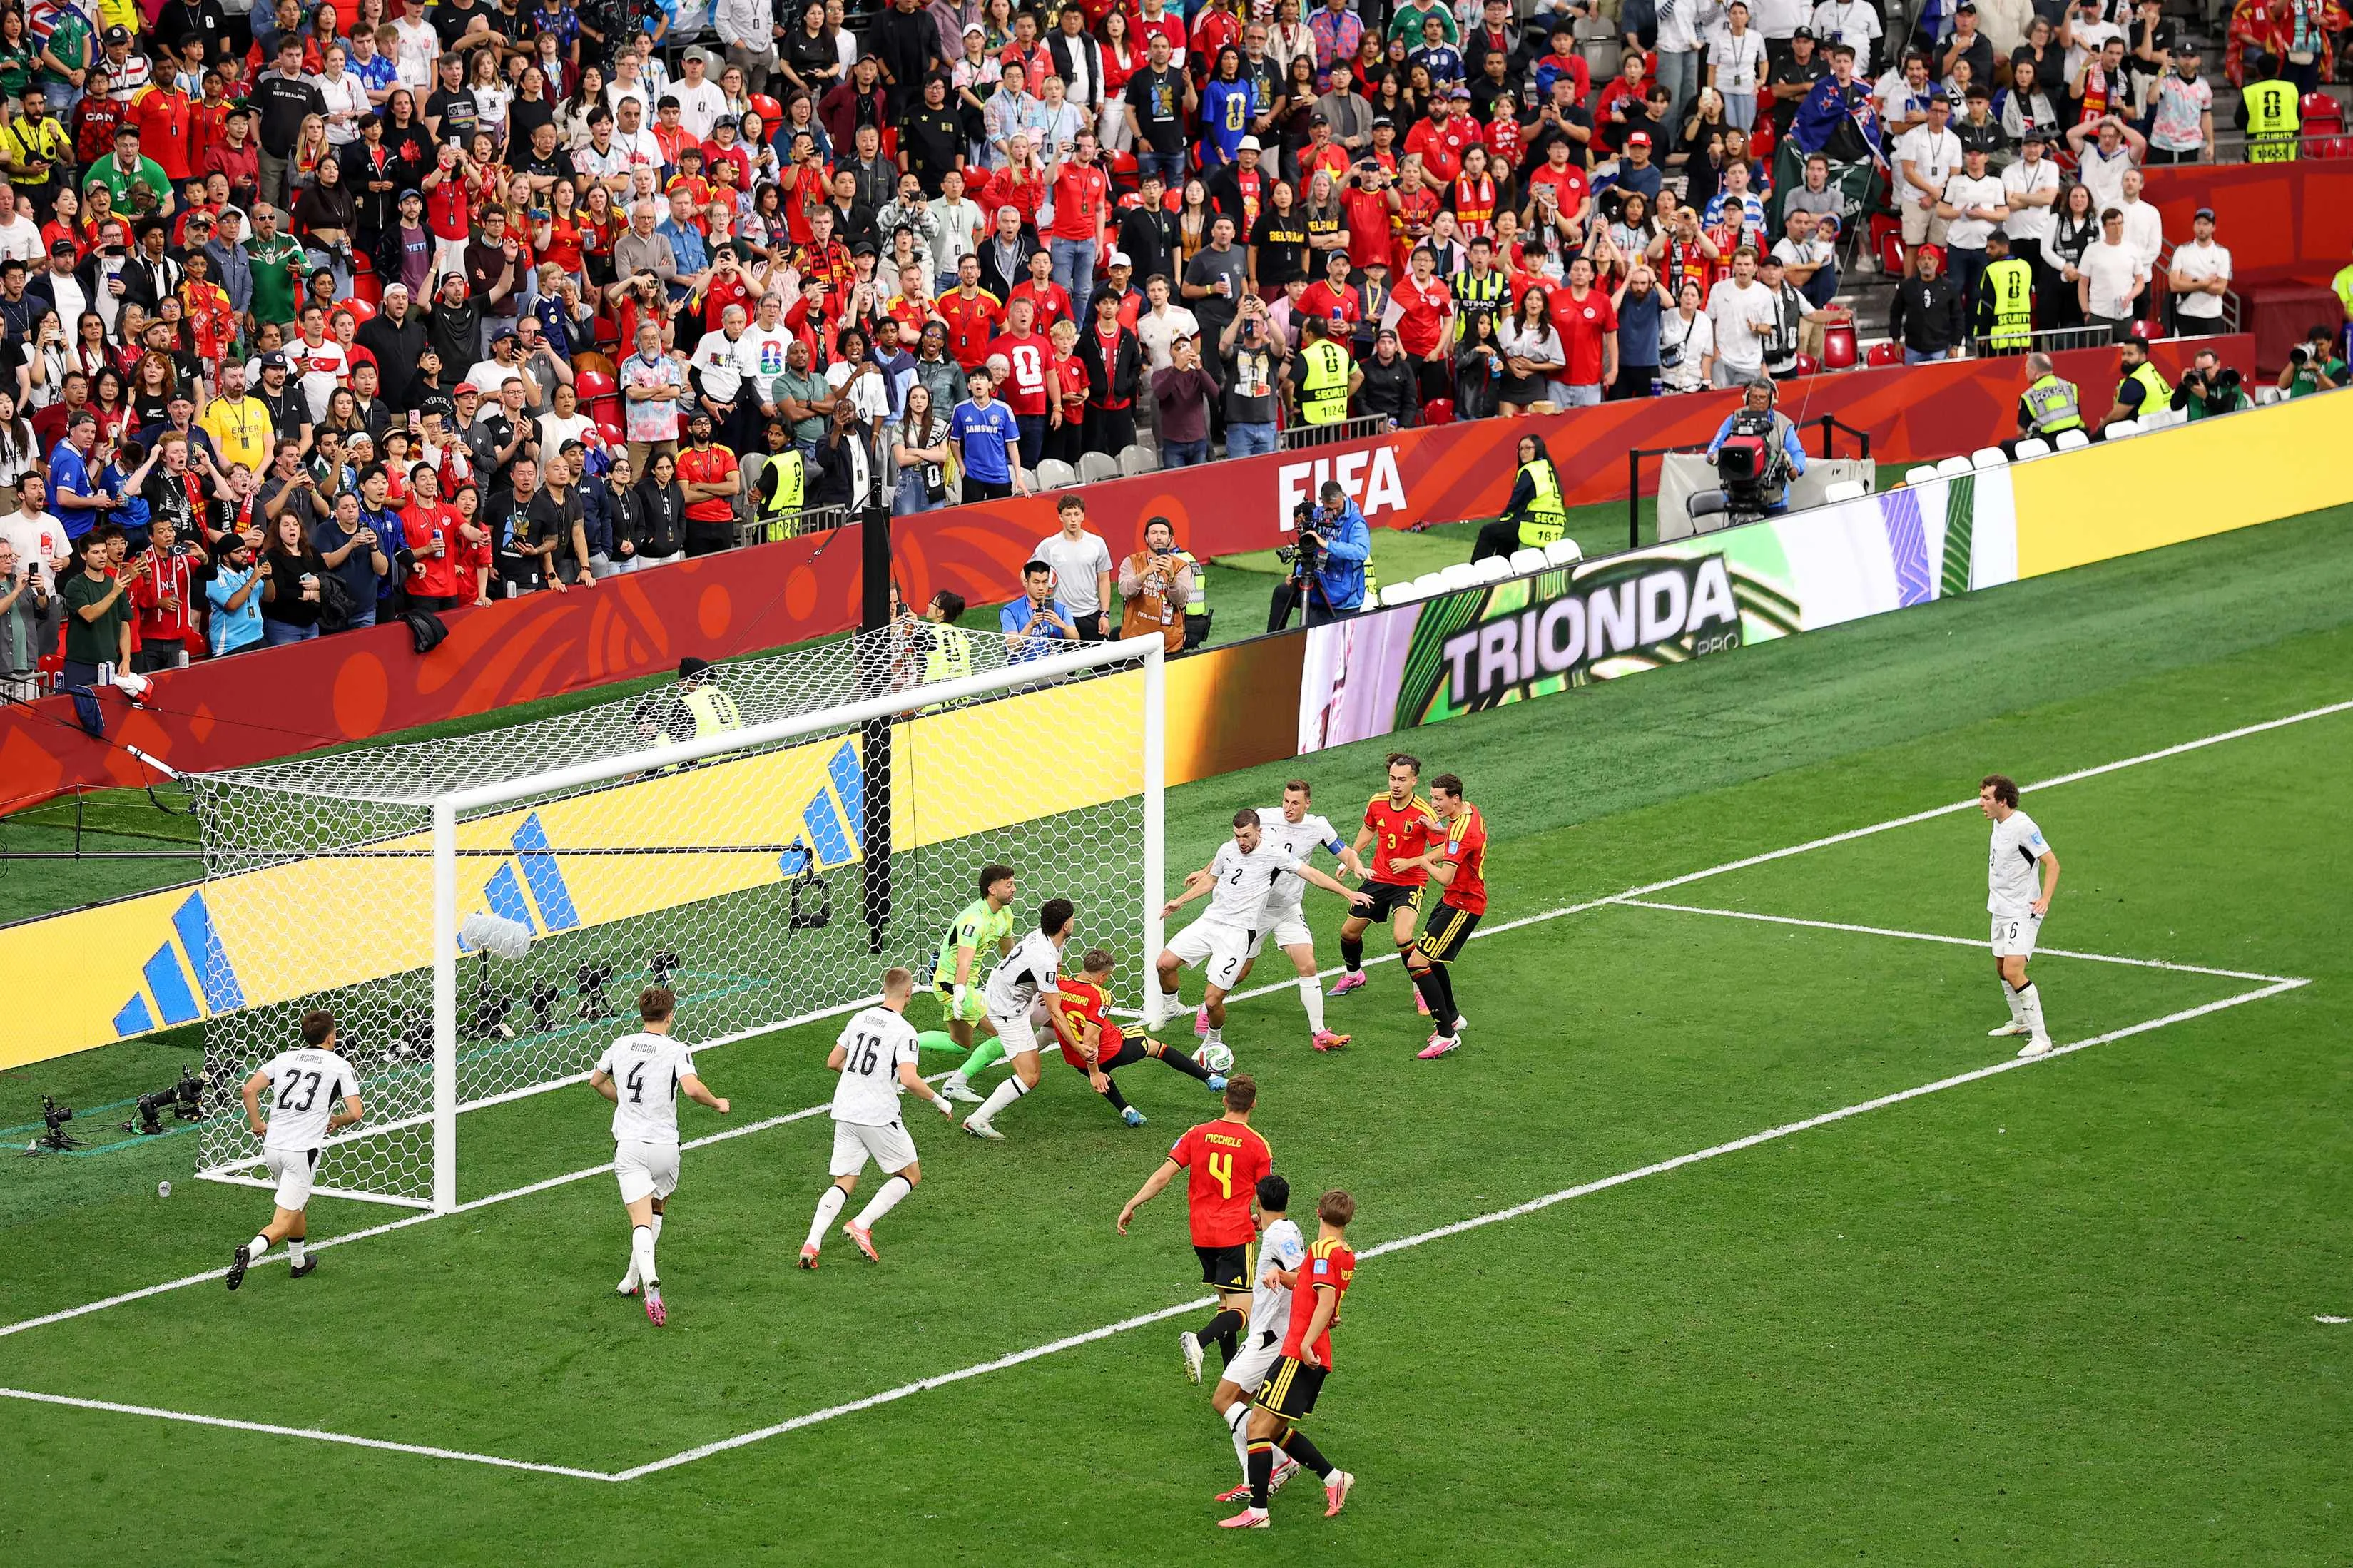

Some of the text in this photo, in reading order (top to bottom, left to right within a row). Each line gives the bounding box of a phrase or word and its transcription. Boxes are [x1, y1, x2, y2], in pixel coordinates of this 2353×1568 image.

[285, 92, 307, 101] ZEALAND
[86, 113, 114, 123] CAN
[1269, 230, 1304, 243] BELGIUM
[407, 242, 427, 252] YETI
[1020, 385, 1045, 395] CANADA
[1137, 611, 1159, 621] FIFA.com
[1443, 556, 1739, 703] TRIONDA
[1697, 633, 1739, 656] PRO
[1388, 833, 1396, 850] 3
[1231, 868, 1243, 885] 2
[1408, 891, 1418, 905] 3
[2009, 921, 2018, 939] 6
[1418, 930, 1437, 953] 20
[1223, 957, 1237, 975] 2
[1059, 990, 1089, 1007] ROSSARD
[631, 1042, 657, 1054] BINDON
[847, 1031, 883, 1076] 16
[295, 1053, 324, 1064] THOMAS
[277, 1067, 322, 1112] 23
[626, 1059, 646, 1105] 4
[1204, 1133, 1243, 1148] MECHELE
[1209, 1151, 1233, 1200] 4
